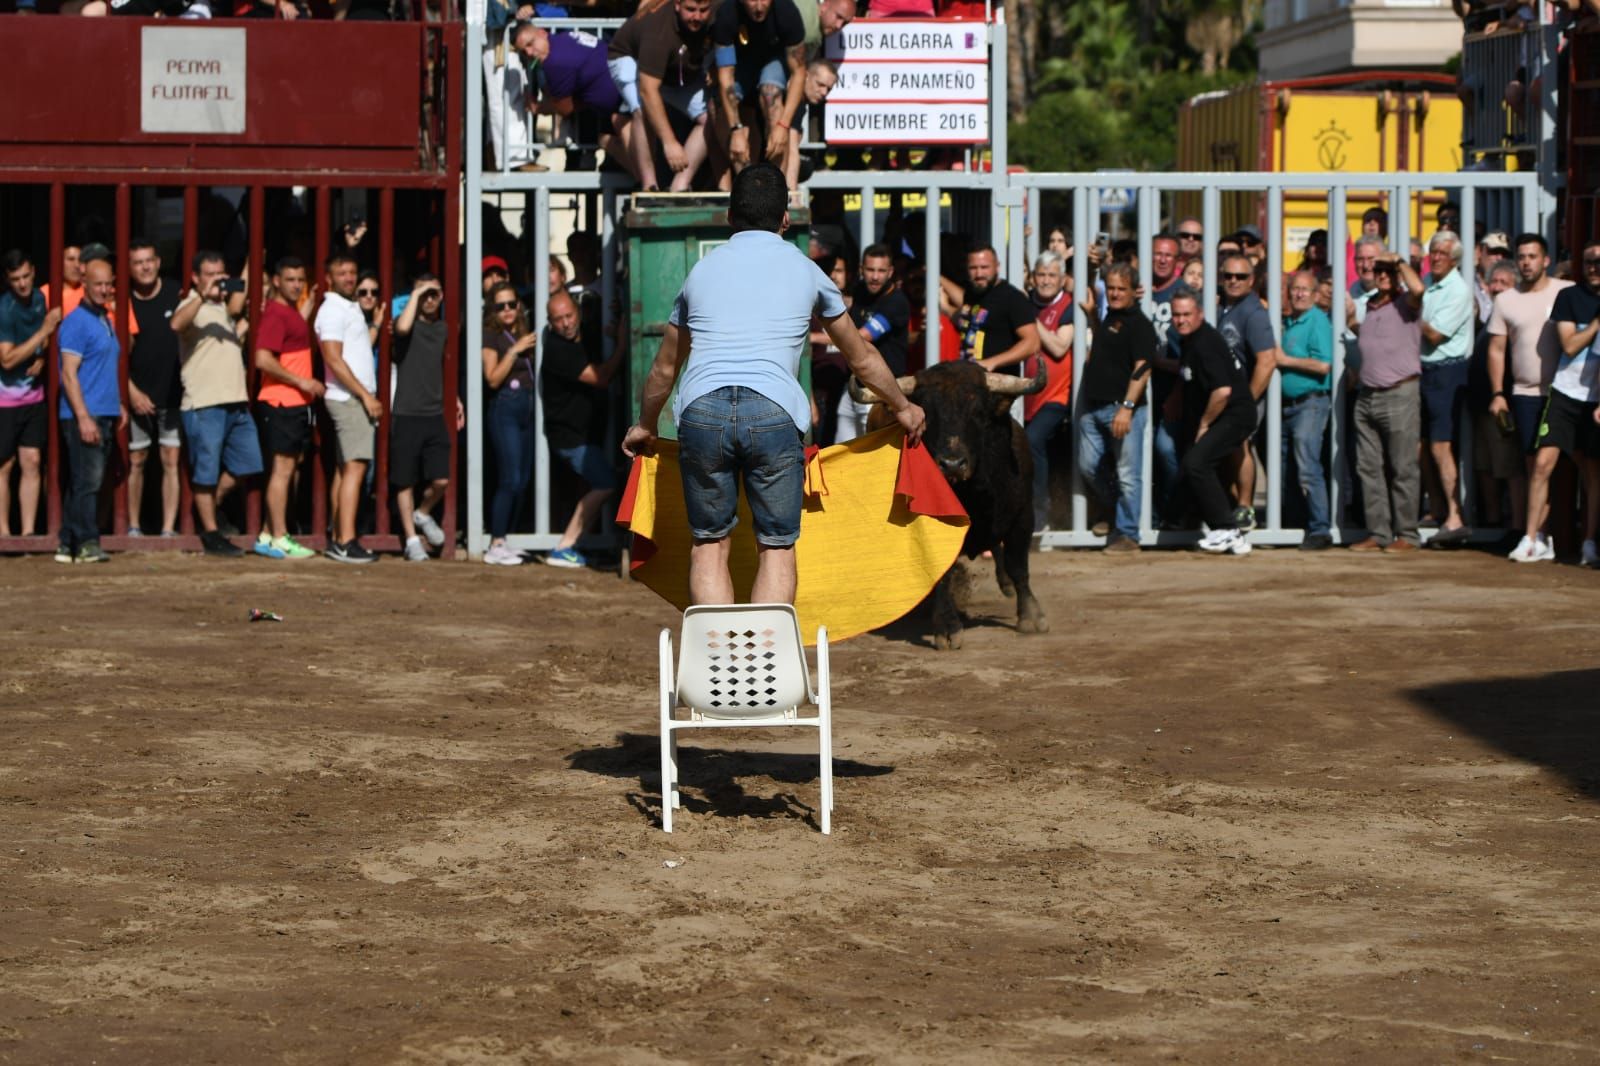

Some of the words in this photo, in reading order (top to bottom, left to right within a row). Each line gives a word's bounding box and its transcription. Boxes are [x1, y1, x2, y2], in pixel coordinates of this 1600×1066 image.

[839, 33, 873, 49] LUIS
[880, 33, 953, 49] ALGARRA
[167, 60, 221, 75] PENYA
[863, 73, 880, 89] 48
[891, 70, 975, 89] PANAMEÑO
[835, 114, 928, 130] NOVIEMBRE
[939, 113, 977, 130] 2016
